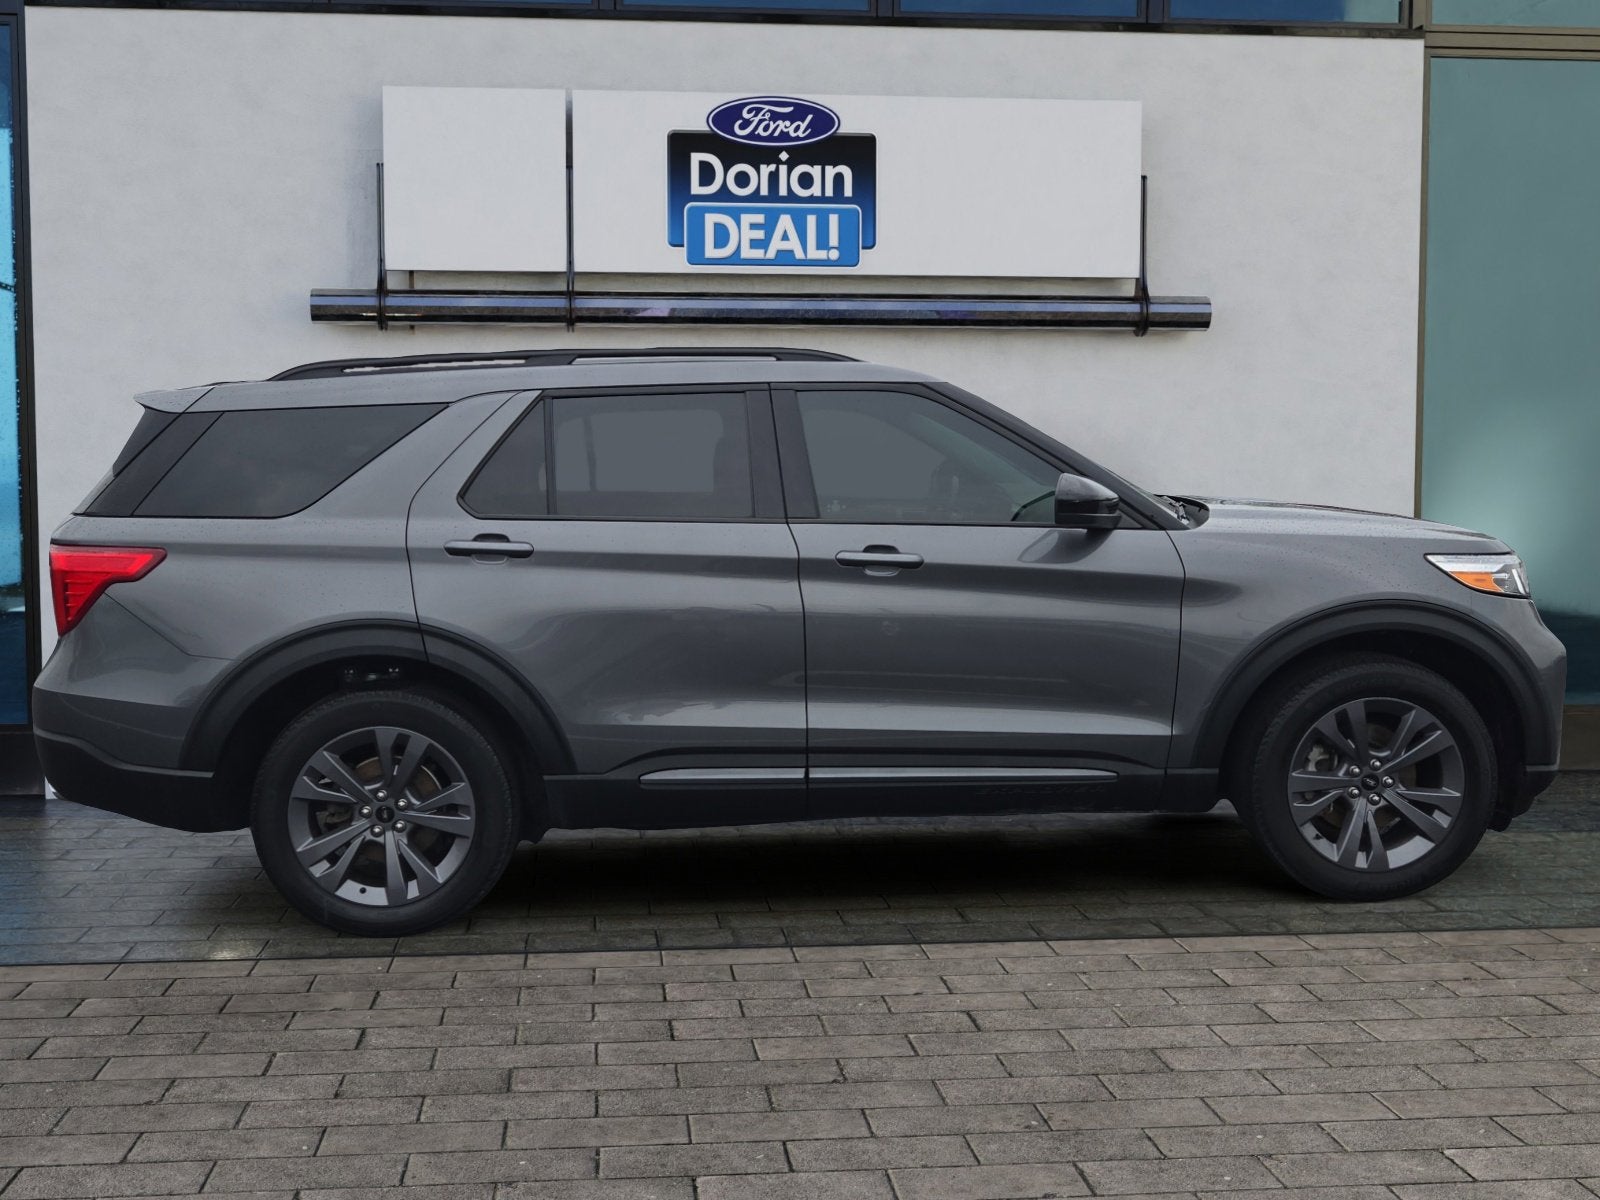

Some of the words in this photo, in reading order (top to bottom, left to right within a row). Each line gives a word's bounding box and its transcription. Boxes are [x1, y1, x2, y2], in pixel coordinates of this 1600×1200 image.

[734, 104, 813, 138] Ford
[690, 151, 853, 197] Dorian
[704, 213, 840, 261] DEAL!
